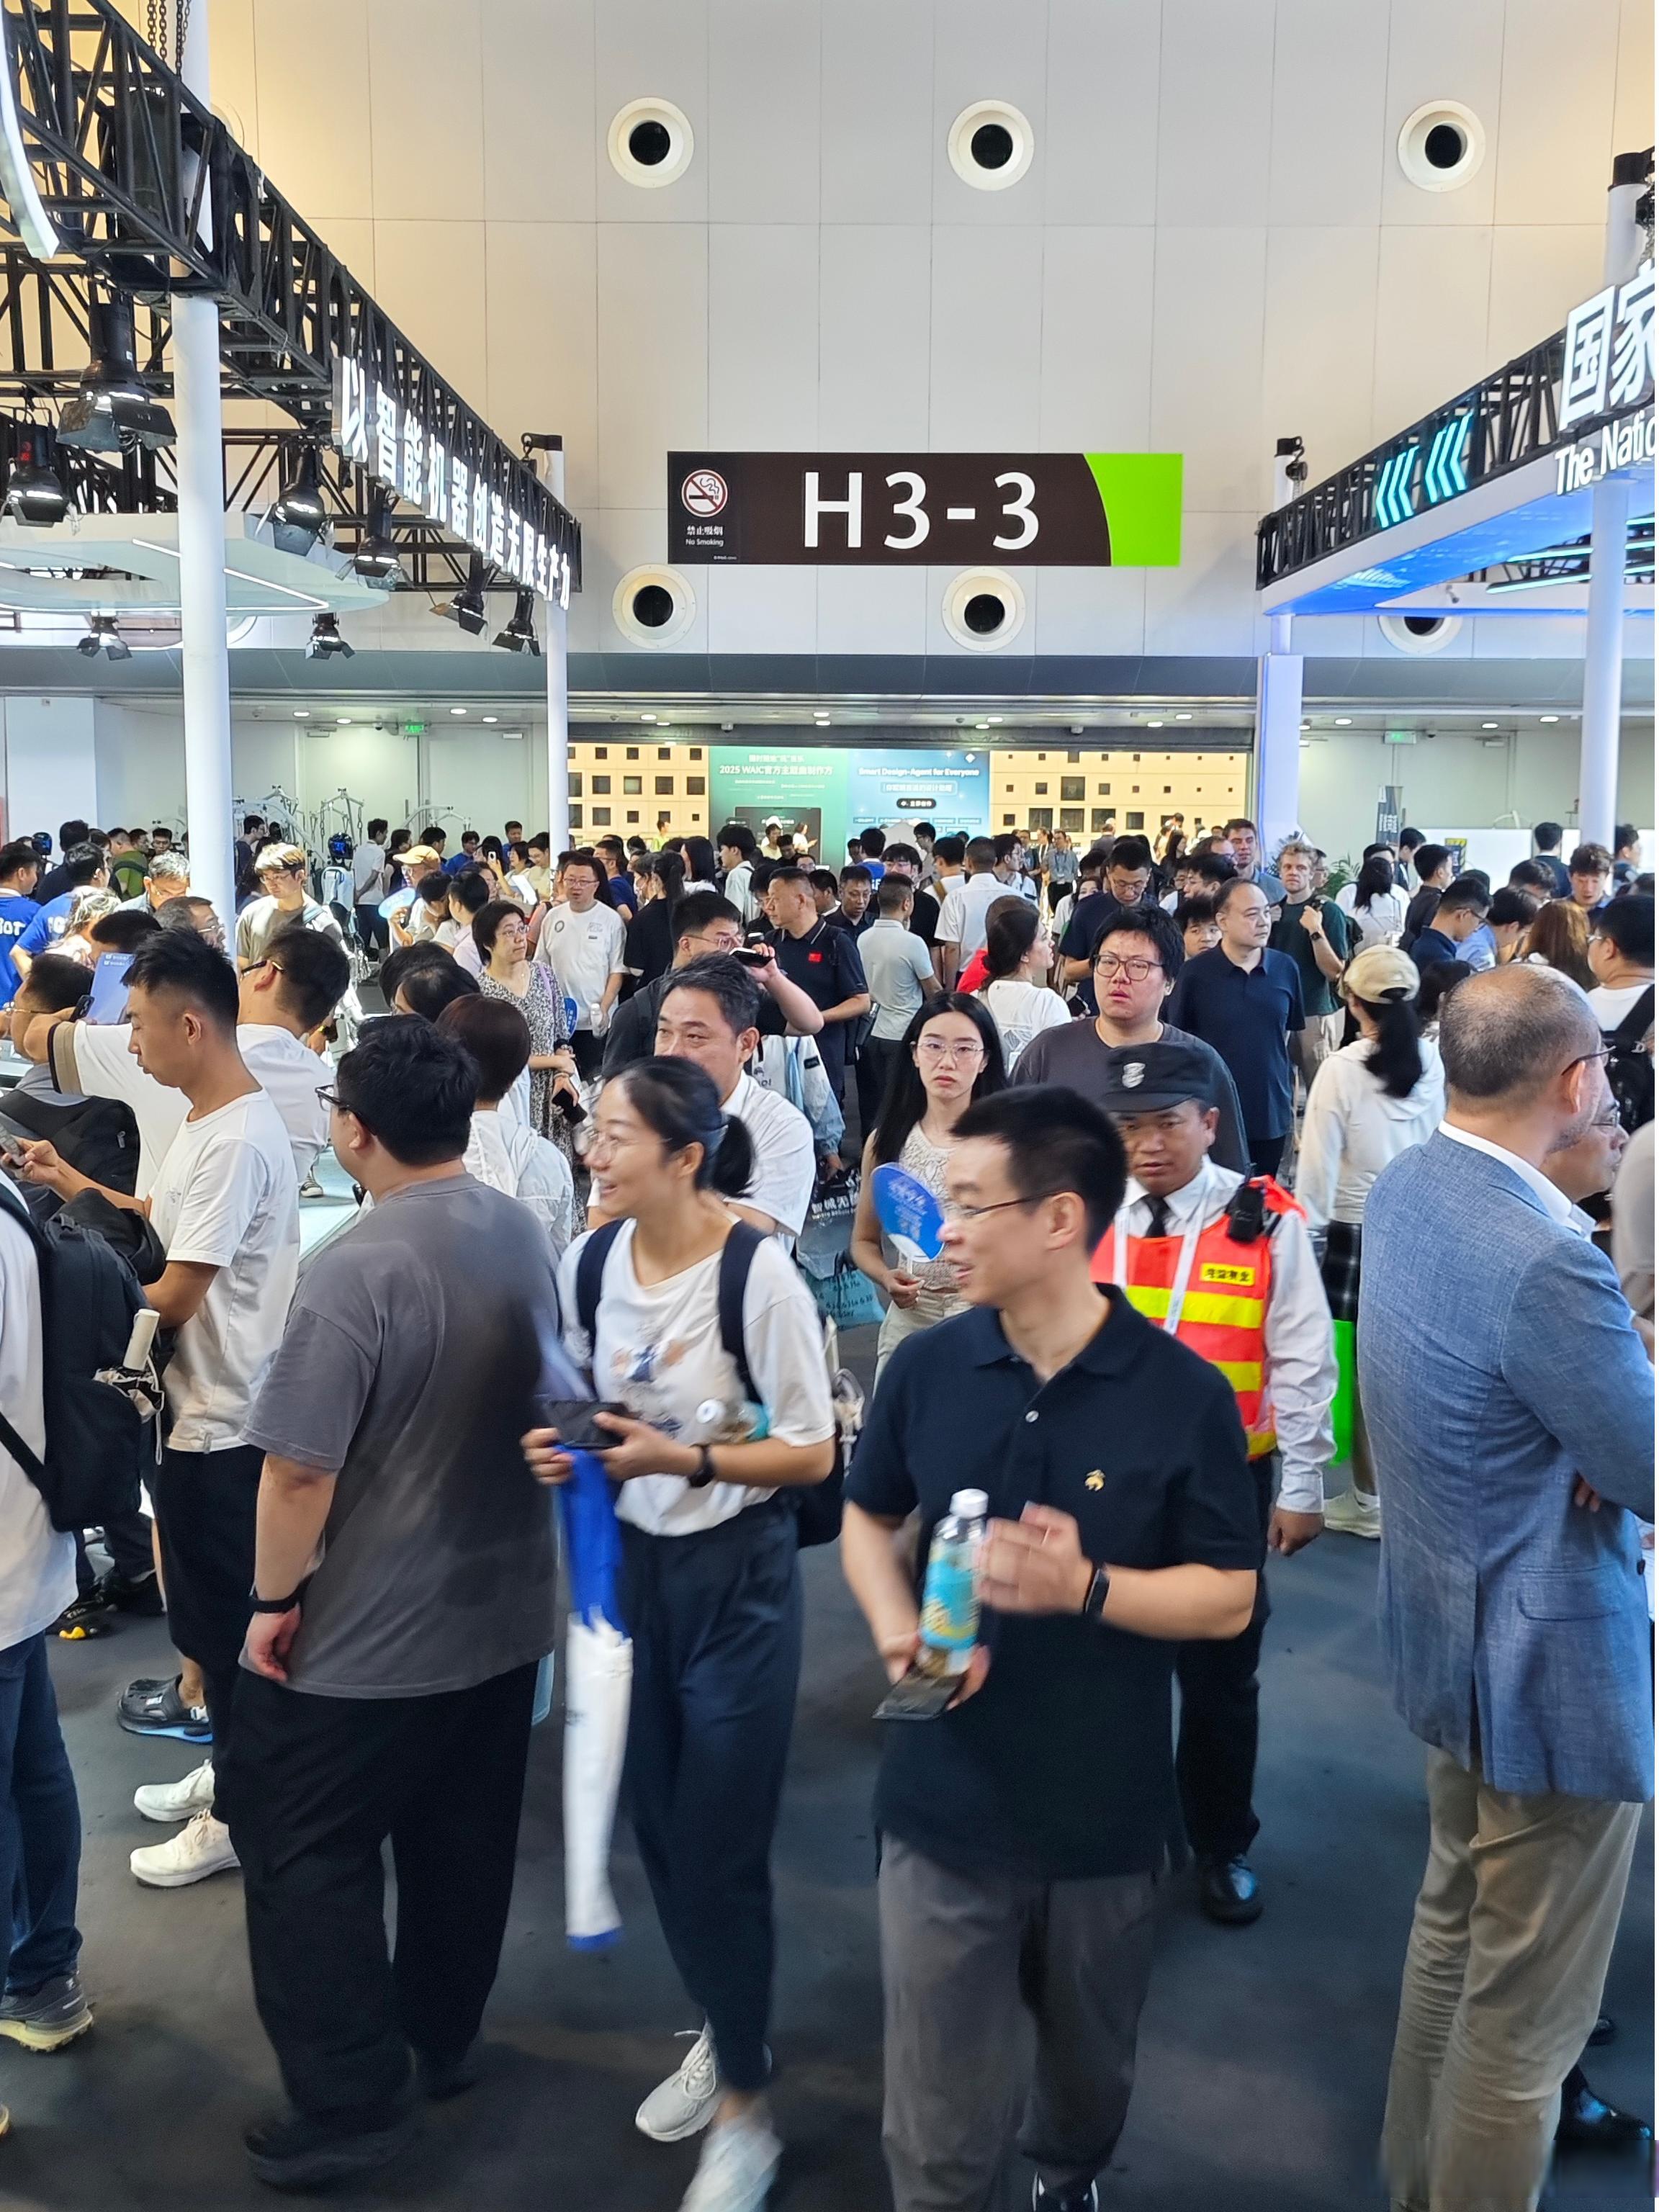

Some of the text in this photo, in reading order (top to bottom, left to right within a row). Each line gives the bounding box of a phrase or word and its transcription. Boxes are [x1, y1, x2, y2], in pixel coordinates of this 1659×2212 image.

[1555, 444, 1594, 495] The
[341, 356, 570, 610] 以智能机器创造无限生产力
[686, 526, 724, 536] 禁止吸烟
[696, 538, 724, 547] Smoking
[719, 765, 740, 774] 2025
[945, 768, 980, 778] Everyone
